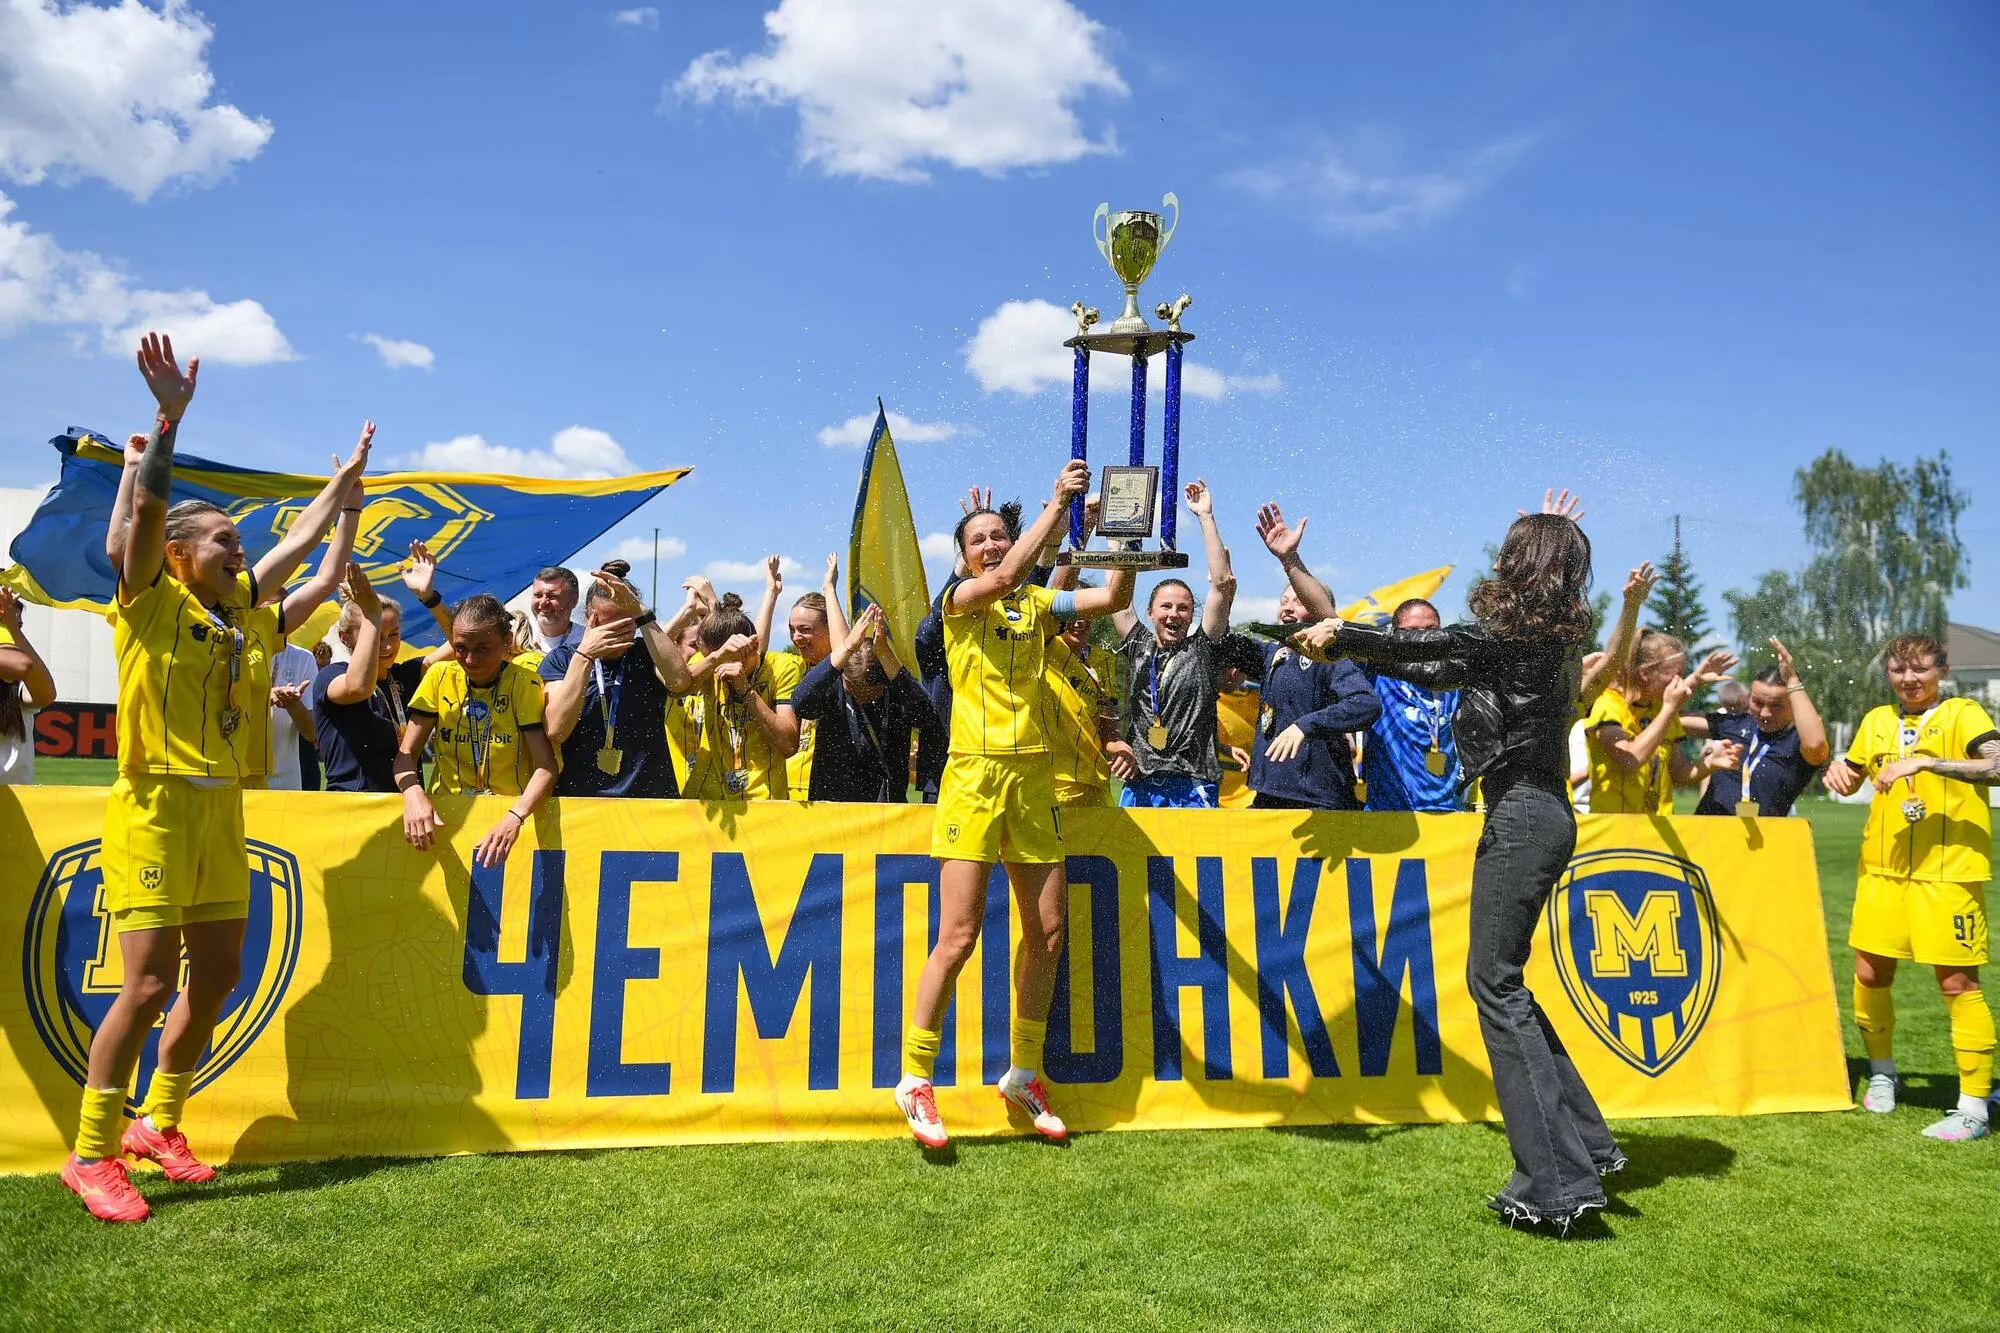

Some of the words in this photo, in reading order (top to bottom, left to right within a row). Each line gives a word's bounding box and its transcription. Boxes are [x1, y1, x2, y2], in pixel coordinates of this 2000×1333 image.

[144, 870, 159, 880] M
[1584, 890, 1688, 977] M
[1953, 914, 1975, 940] 97
[462, 848, 1443, 1100] ЧЕМПІОНКИ
[1628, 990, 1659, 1005] 1925
